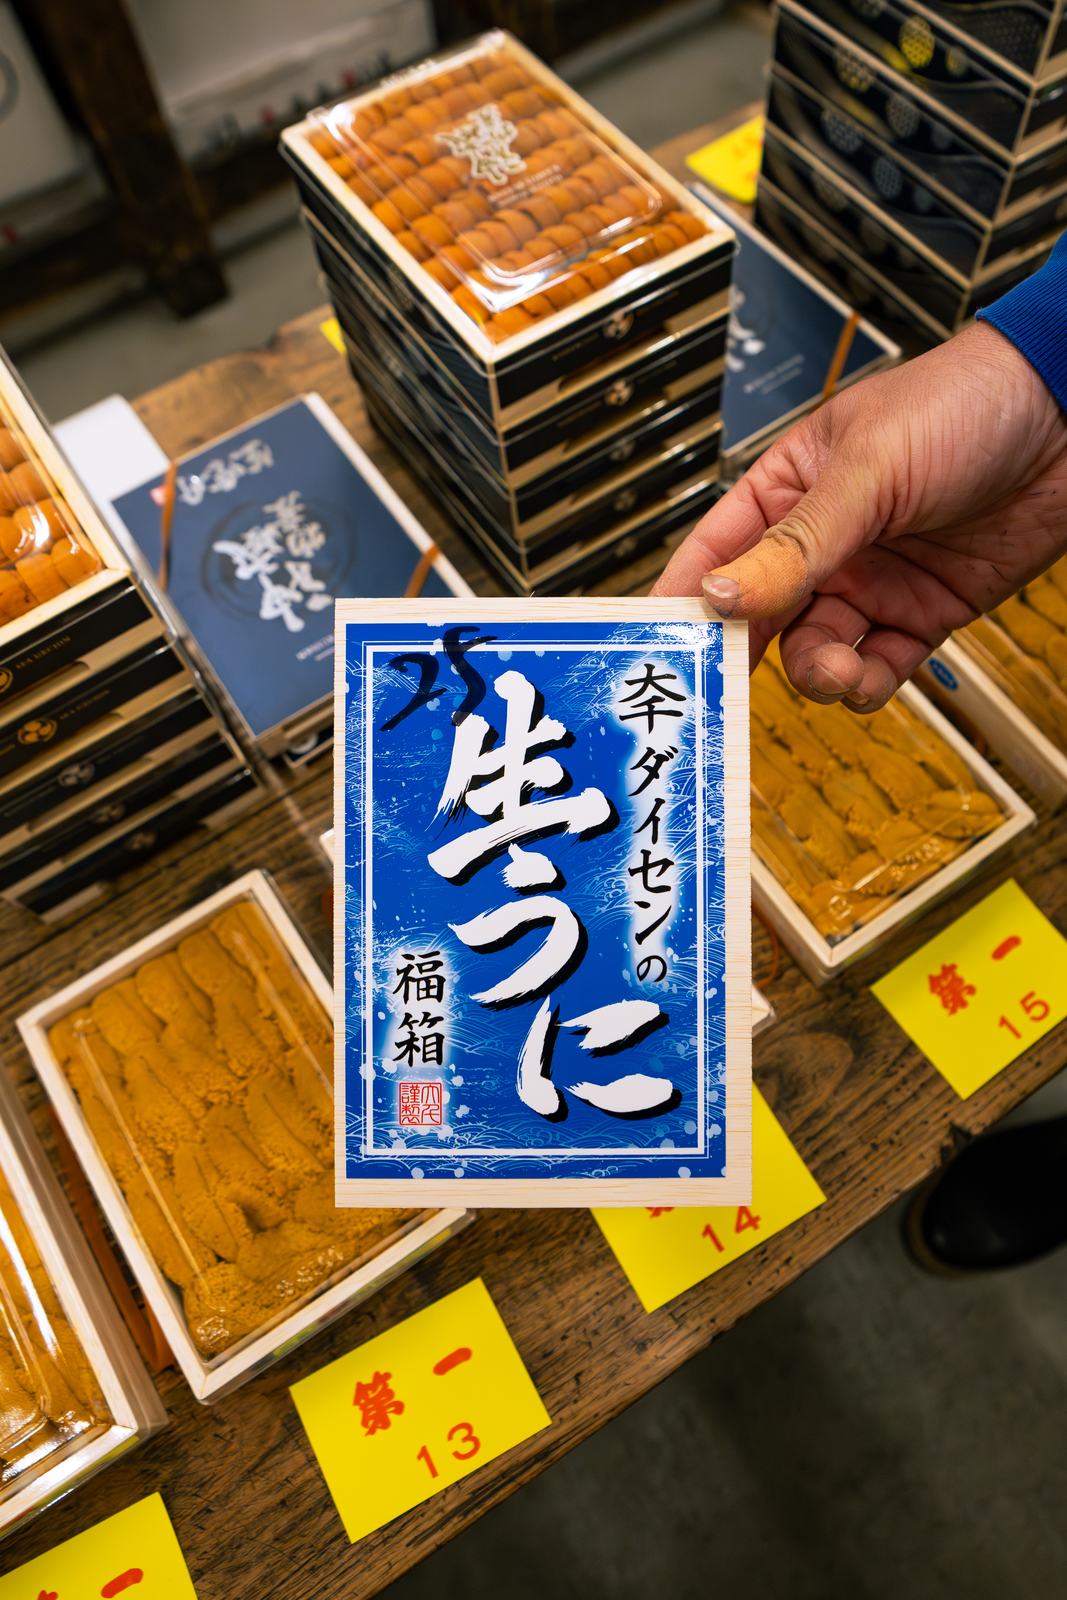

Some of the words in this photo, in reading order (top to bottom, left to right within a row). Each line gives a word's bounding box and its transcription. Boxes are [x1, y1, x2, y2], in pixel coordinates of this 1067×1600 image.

[426, 670, 681, 1123] 生うに
[392, 950, 447, 1068] 福箱
[927, 935, 1021, 1015] 第一
[999, 991, 1050, 1039] 15
[701, 1206, 761, 1253] 14
[353, 1347, 472, 1436] 第一
[417, 1422, 481, 1478] 13
